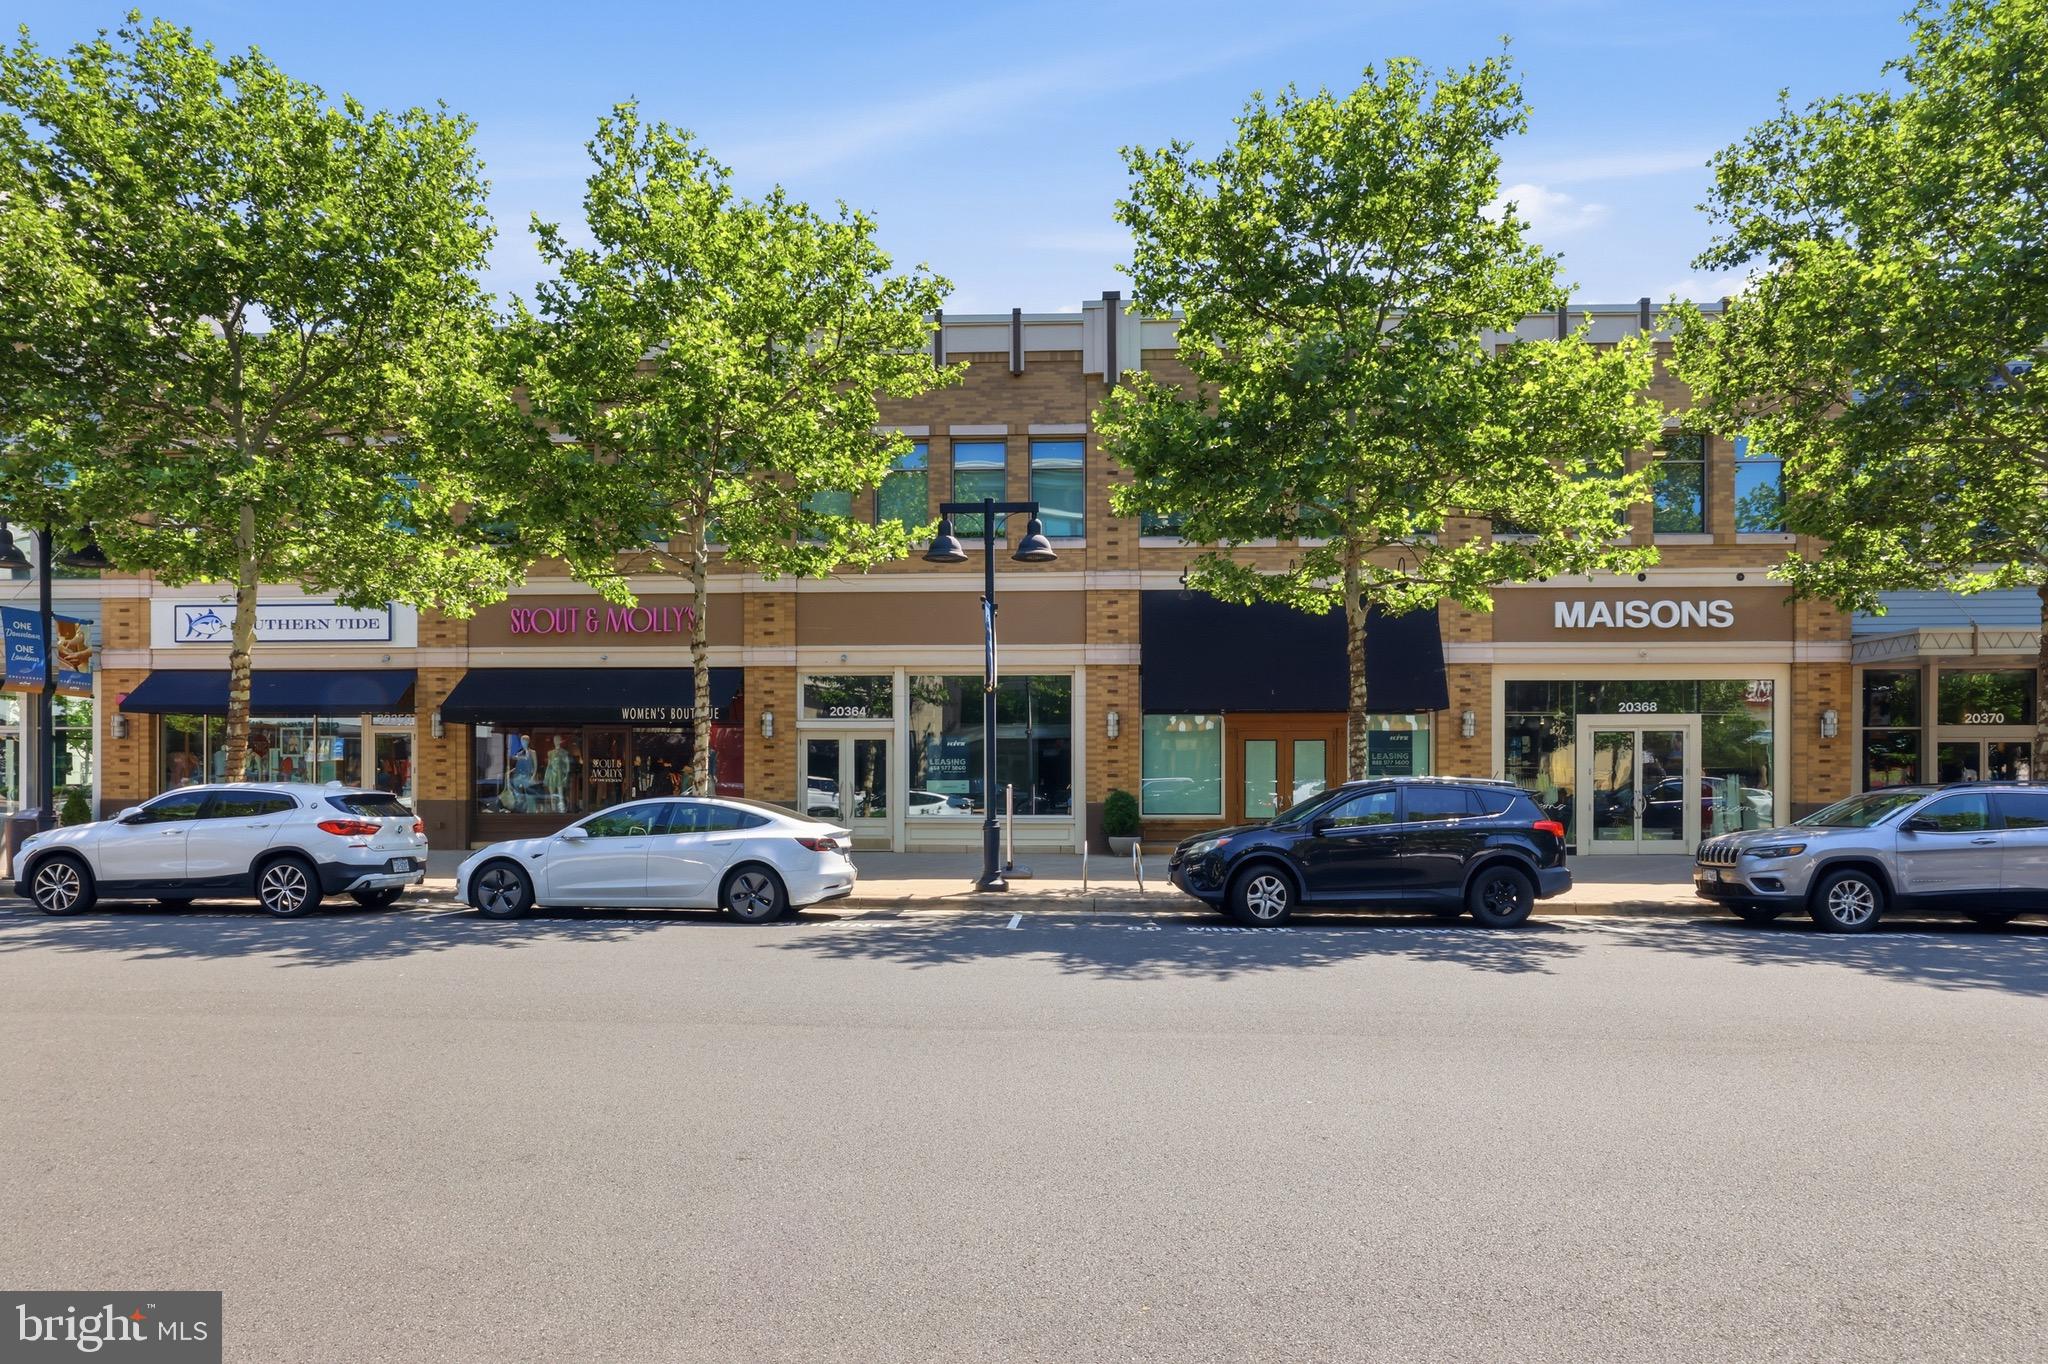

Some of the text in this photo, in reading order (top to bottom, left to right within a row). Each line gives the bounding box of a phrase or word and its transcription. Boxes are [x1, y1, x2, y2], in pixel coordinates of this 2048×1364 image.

[1554, 600, 1734, 628] MAISONS
[13, 621, 32, 631] ONE
[231, 618, 380, 631] UTHERN TIDE
[511, 608, 579, 633] SCOUT
[586, 608, 600, 633] &
[15, 644, 35, 654] ONE
[830, 706, 867, 716] 20364
[1618, 701, 1658, 713] 20368
[621, 707, 720, 720] WOMEN'S BOUTUE
[1964, 712, 2005, 724] 20370
[1371, 752, 1409, 760] LEASING
